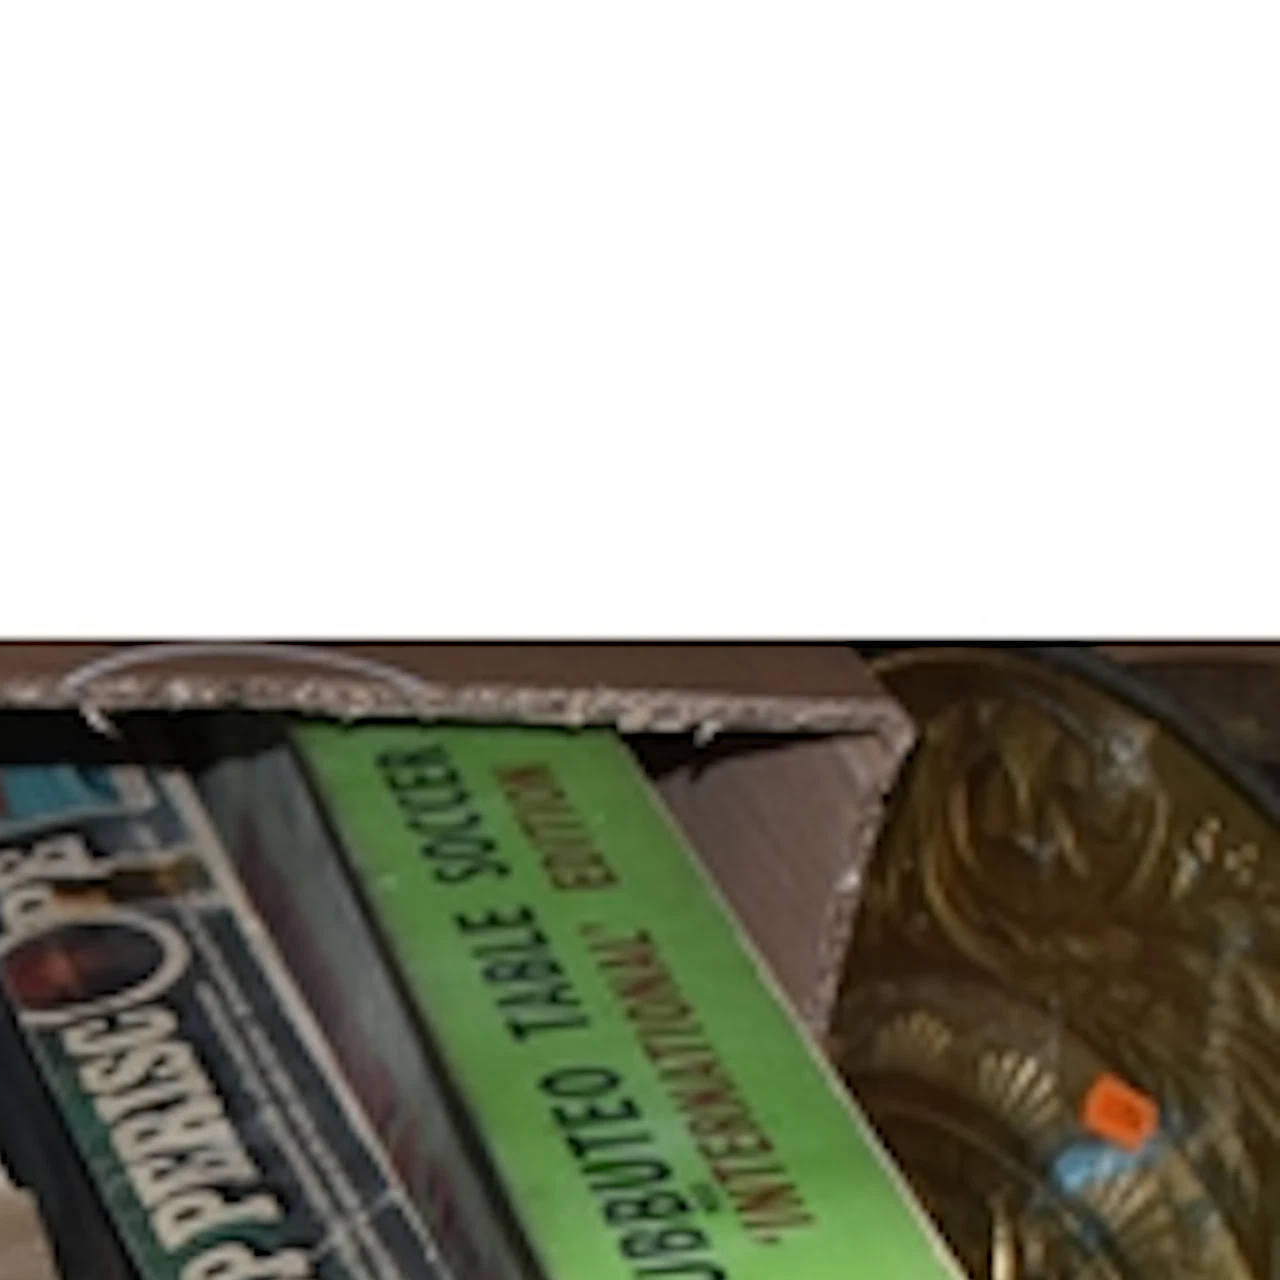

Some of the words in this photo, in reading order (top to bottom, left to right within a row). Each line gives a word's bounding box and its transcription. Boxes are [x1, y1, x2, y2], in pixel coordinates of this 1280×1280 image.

[375, 744, 509, 885] SOCCER
[492, 760, 618, 891] EDITION
[455, 902, 591, 1044] TABLE
